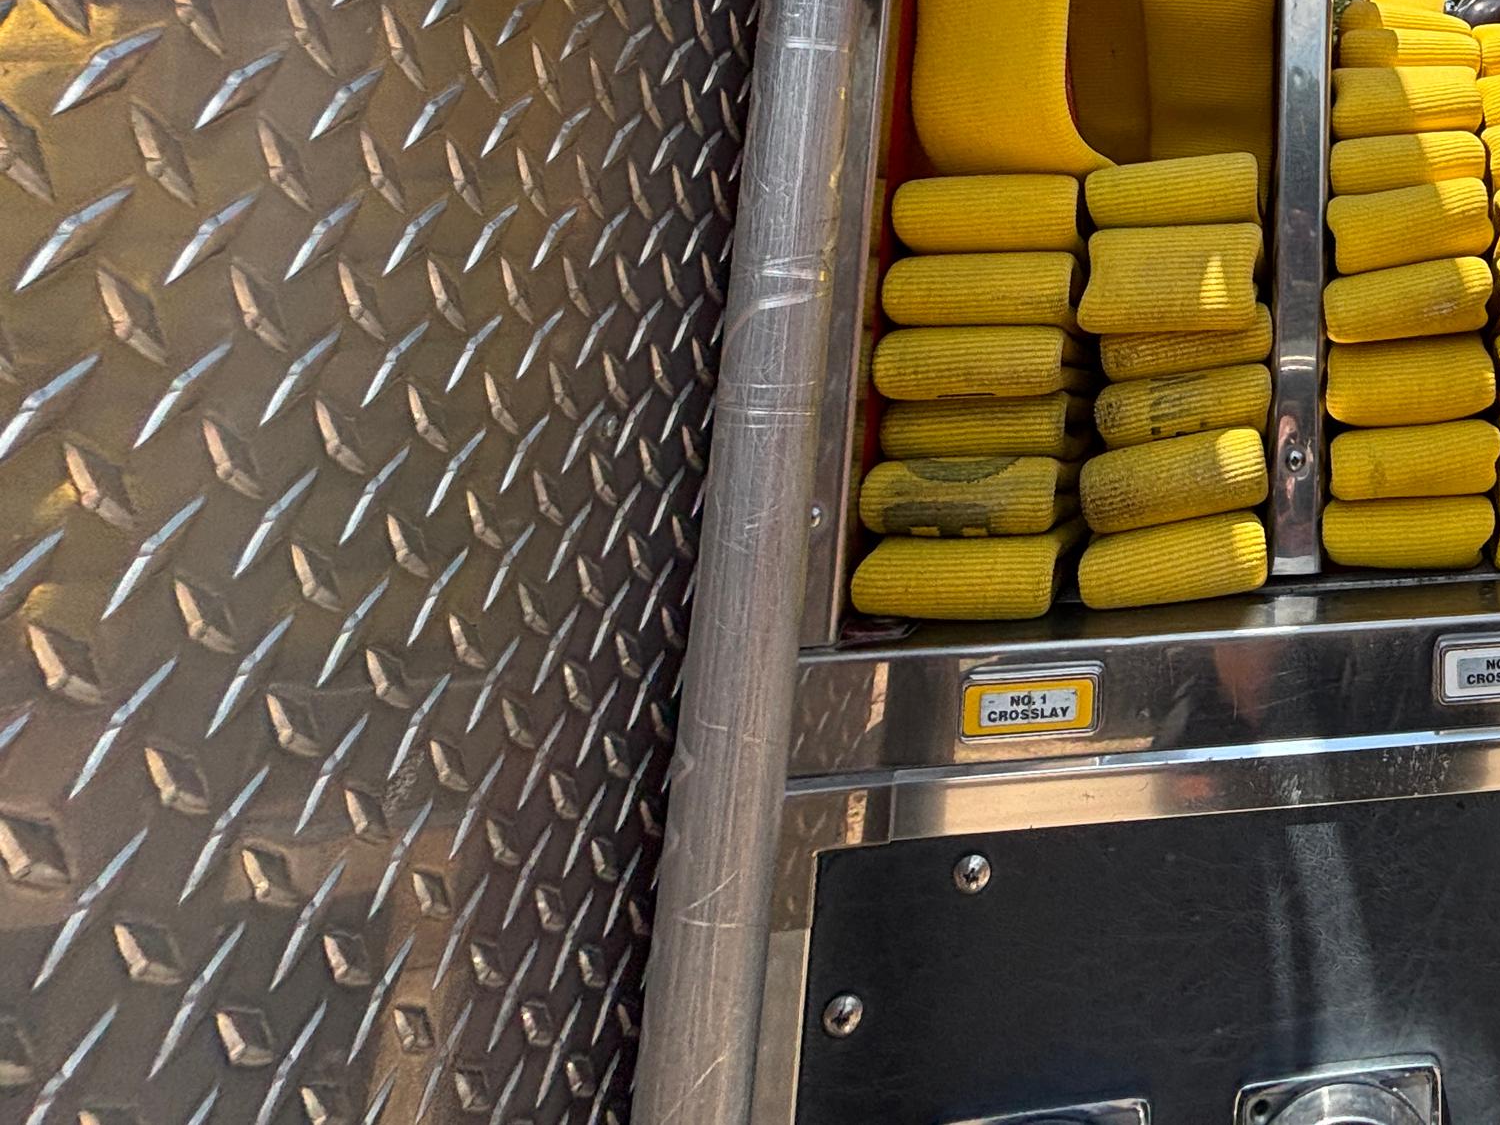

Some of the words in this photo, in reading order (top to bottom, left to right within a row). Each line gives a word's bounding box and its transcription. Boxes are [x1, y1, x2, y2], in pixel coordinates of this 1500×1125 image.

[1009, 695, 1036, 707] NO.
[1040, 693, 1047, 705] 1
[987, 706, 1071, 723] CROSSLAY
